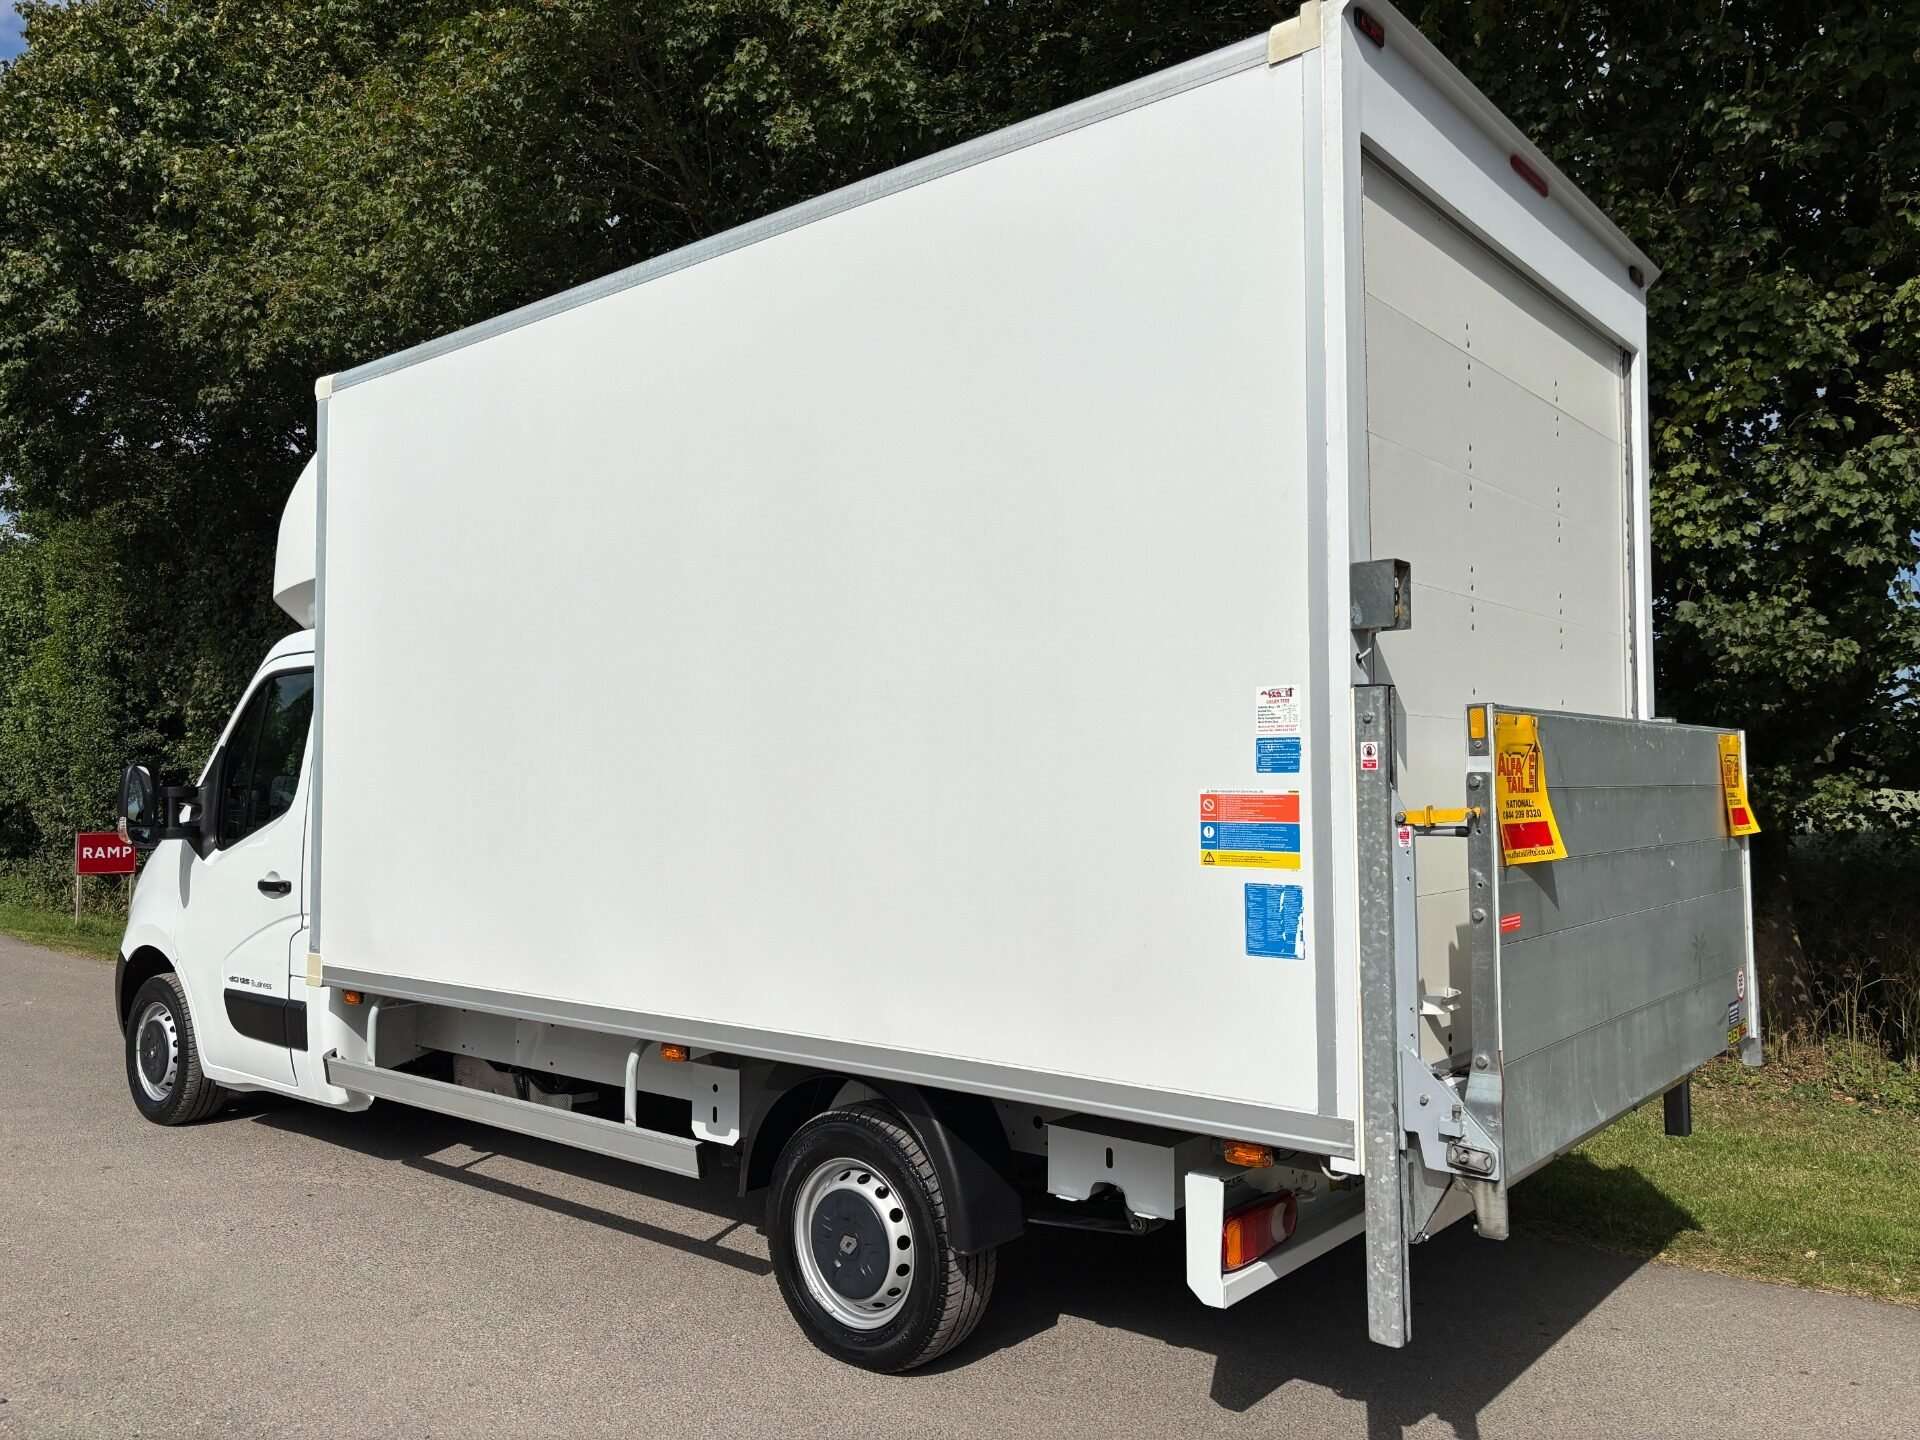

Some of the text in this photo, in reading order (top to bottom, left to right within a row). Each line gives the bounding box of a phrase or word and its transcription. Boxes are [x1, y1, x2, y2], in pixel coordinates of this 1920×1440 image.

[1497, 752, 1523, 776] ALFA
[1505, 776, 1525, 793] TAIL
[82, 846, 132, 859] RAMP
